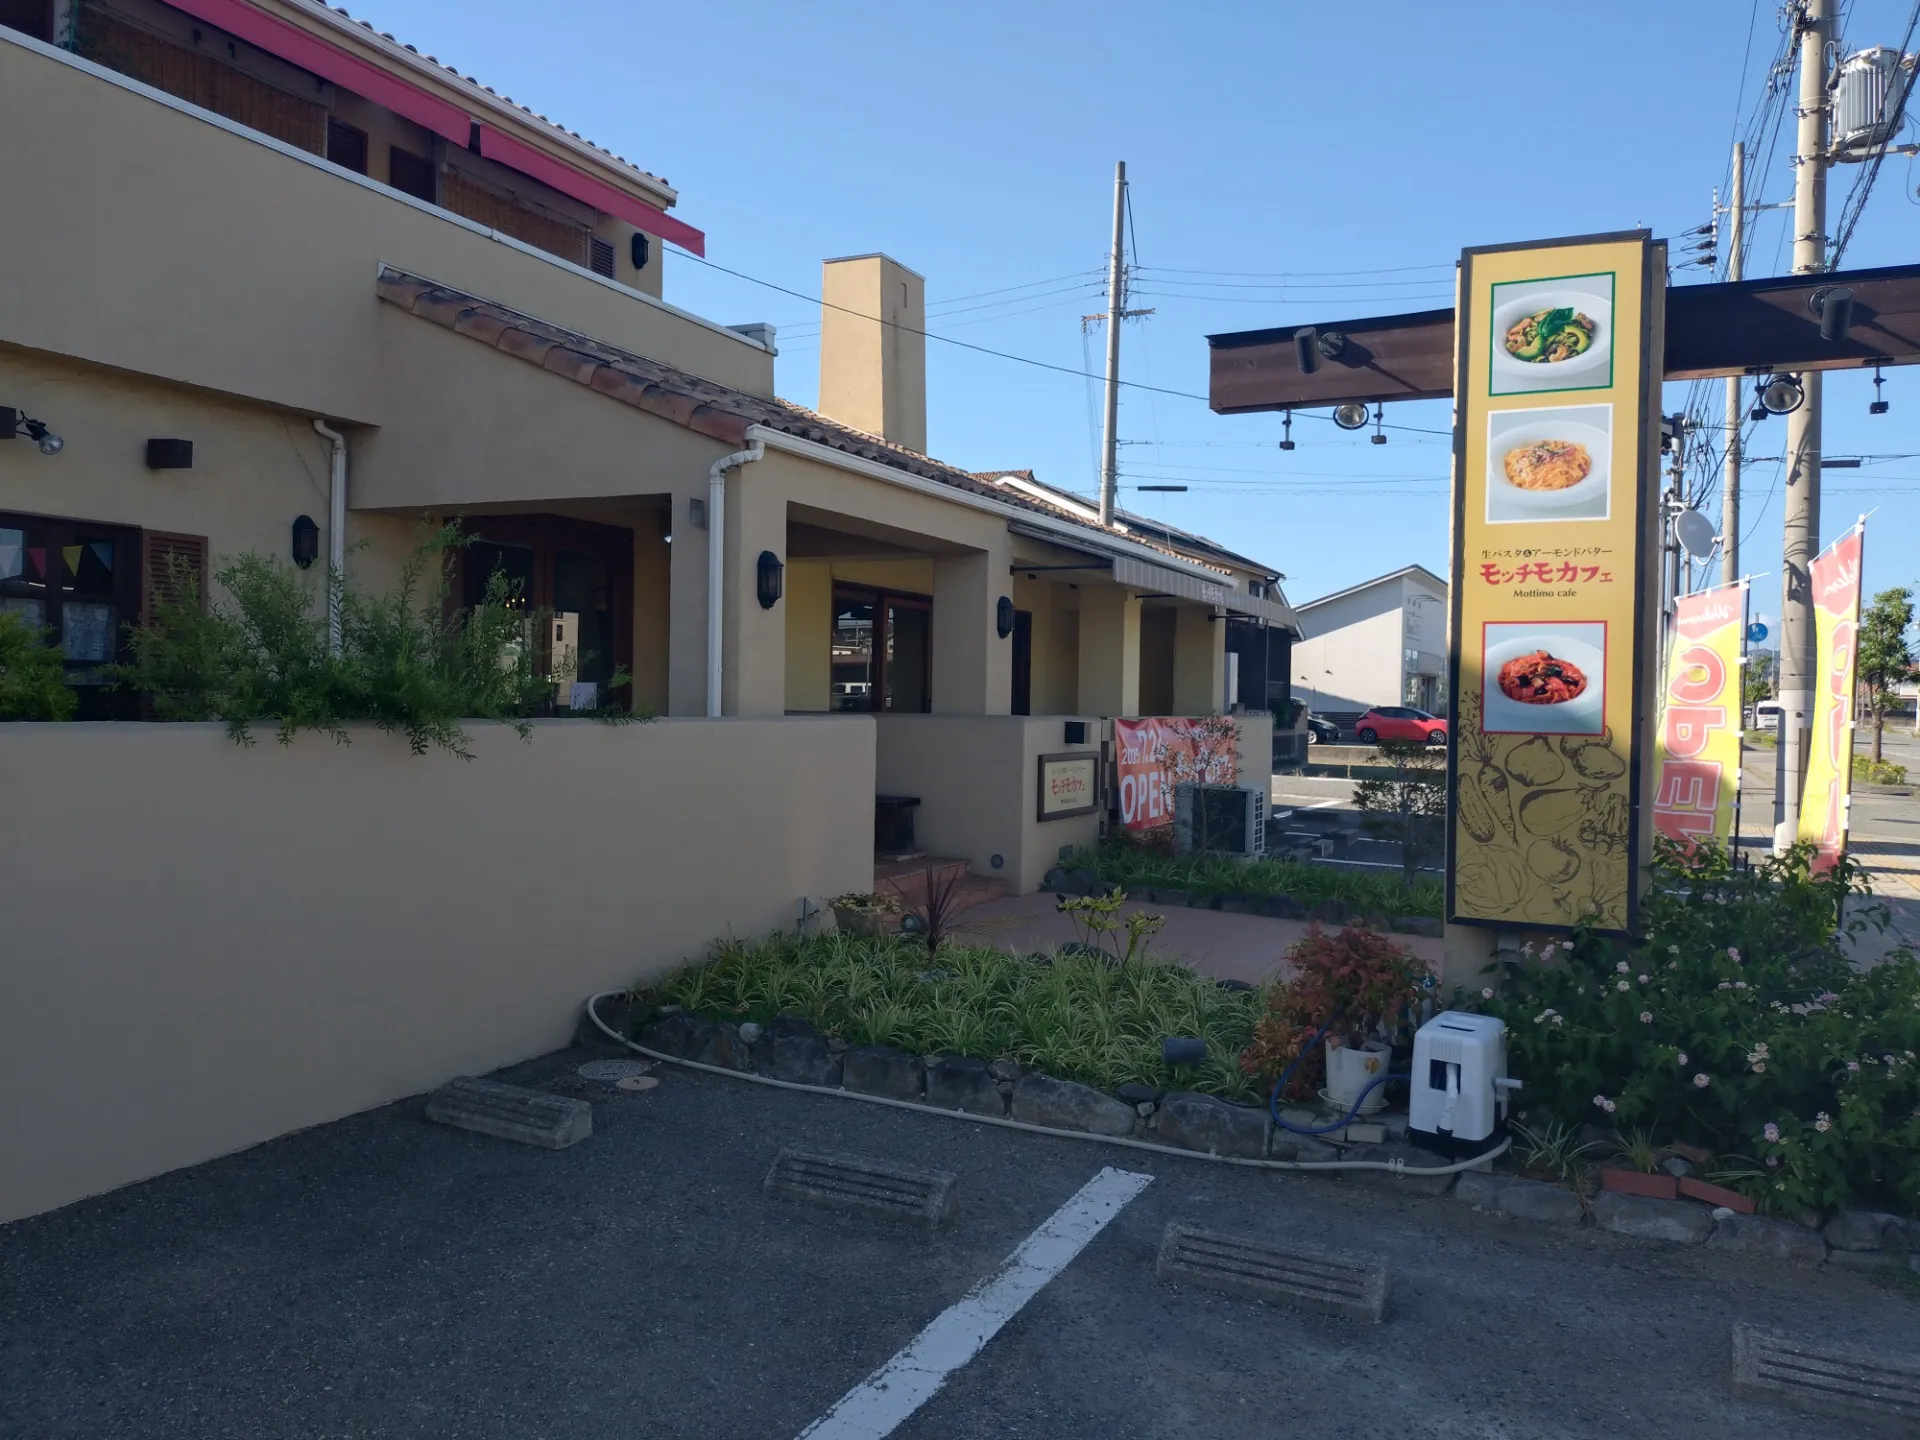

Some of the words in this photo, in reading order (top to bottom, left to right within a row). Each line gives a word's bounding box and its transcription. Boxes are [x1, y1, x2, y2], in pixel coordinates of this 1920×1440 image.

[1479, 561, 1614, 585] モッチモカフェ
[1513, 588, 1555, 598] Mottimo
[1557, 587, 1577, 598] cafe
[1120, 770, 1174, 825] OPEN
